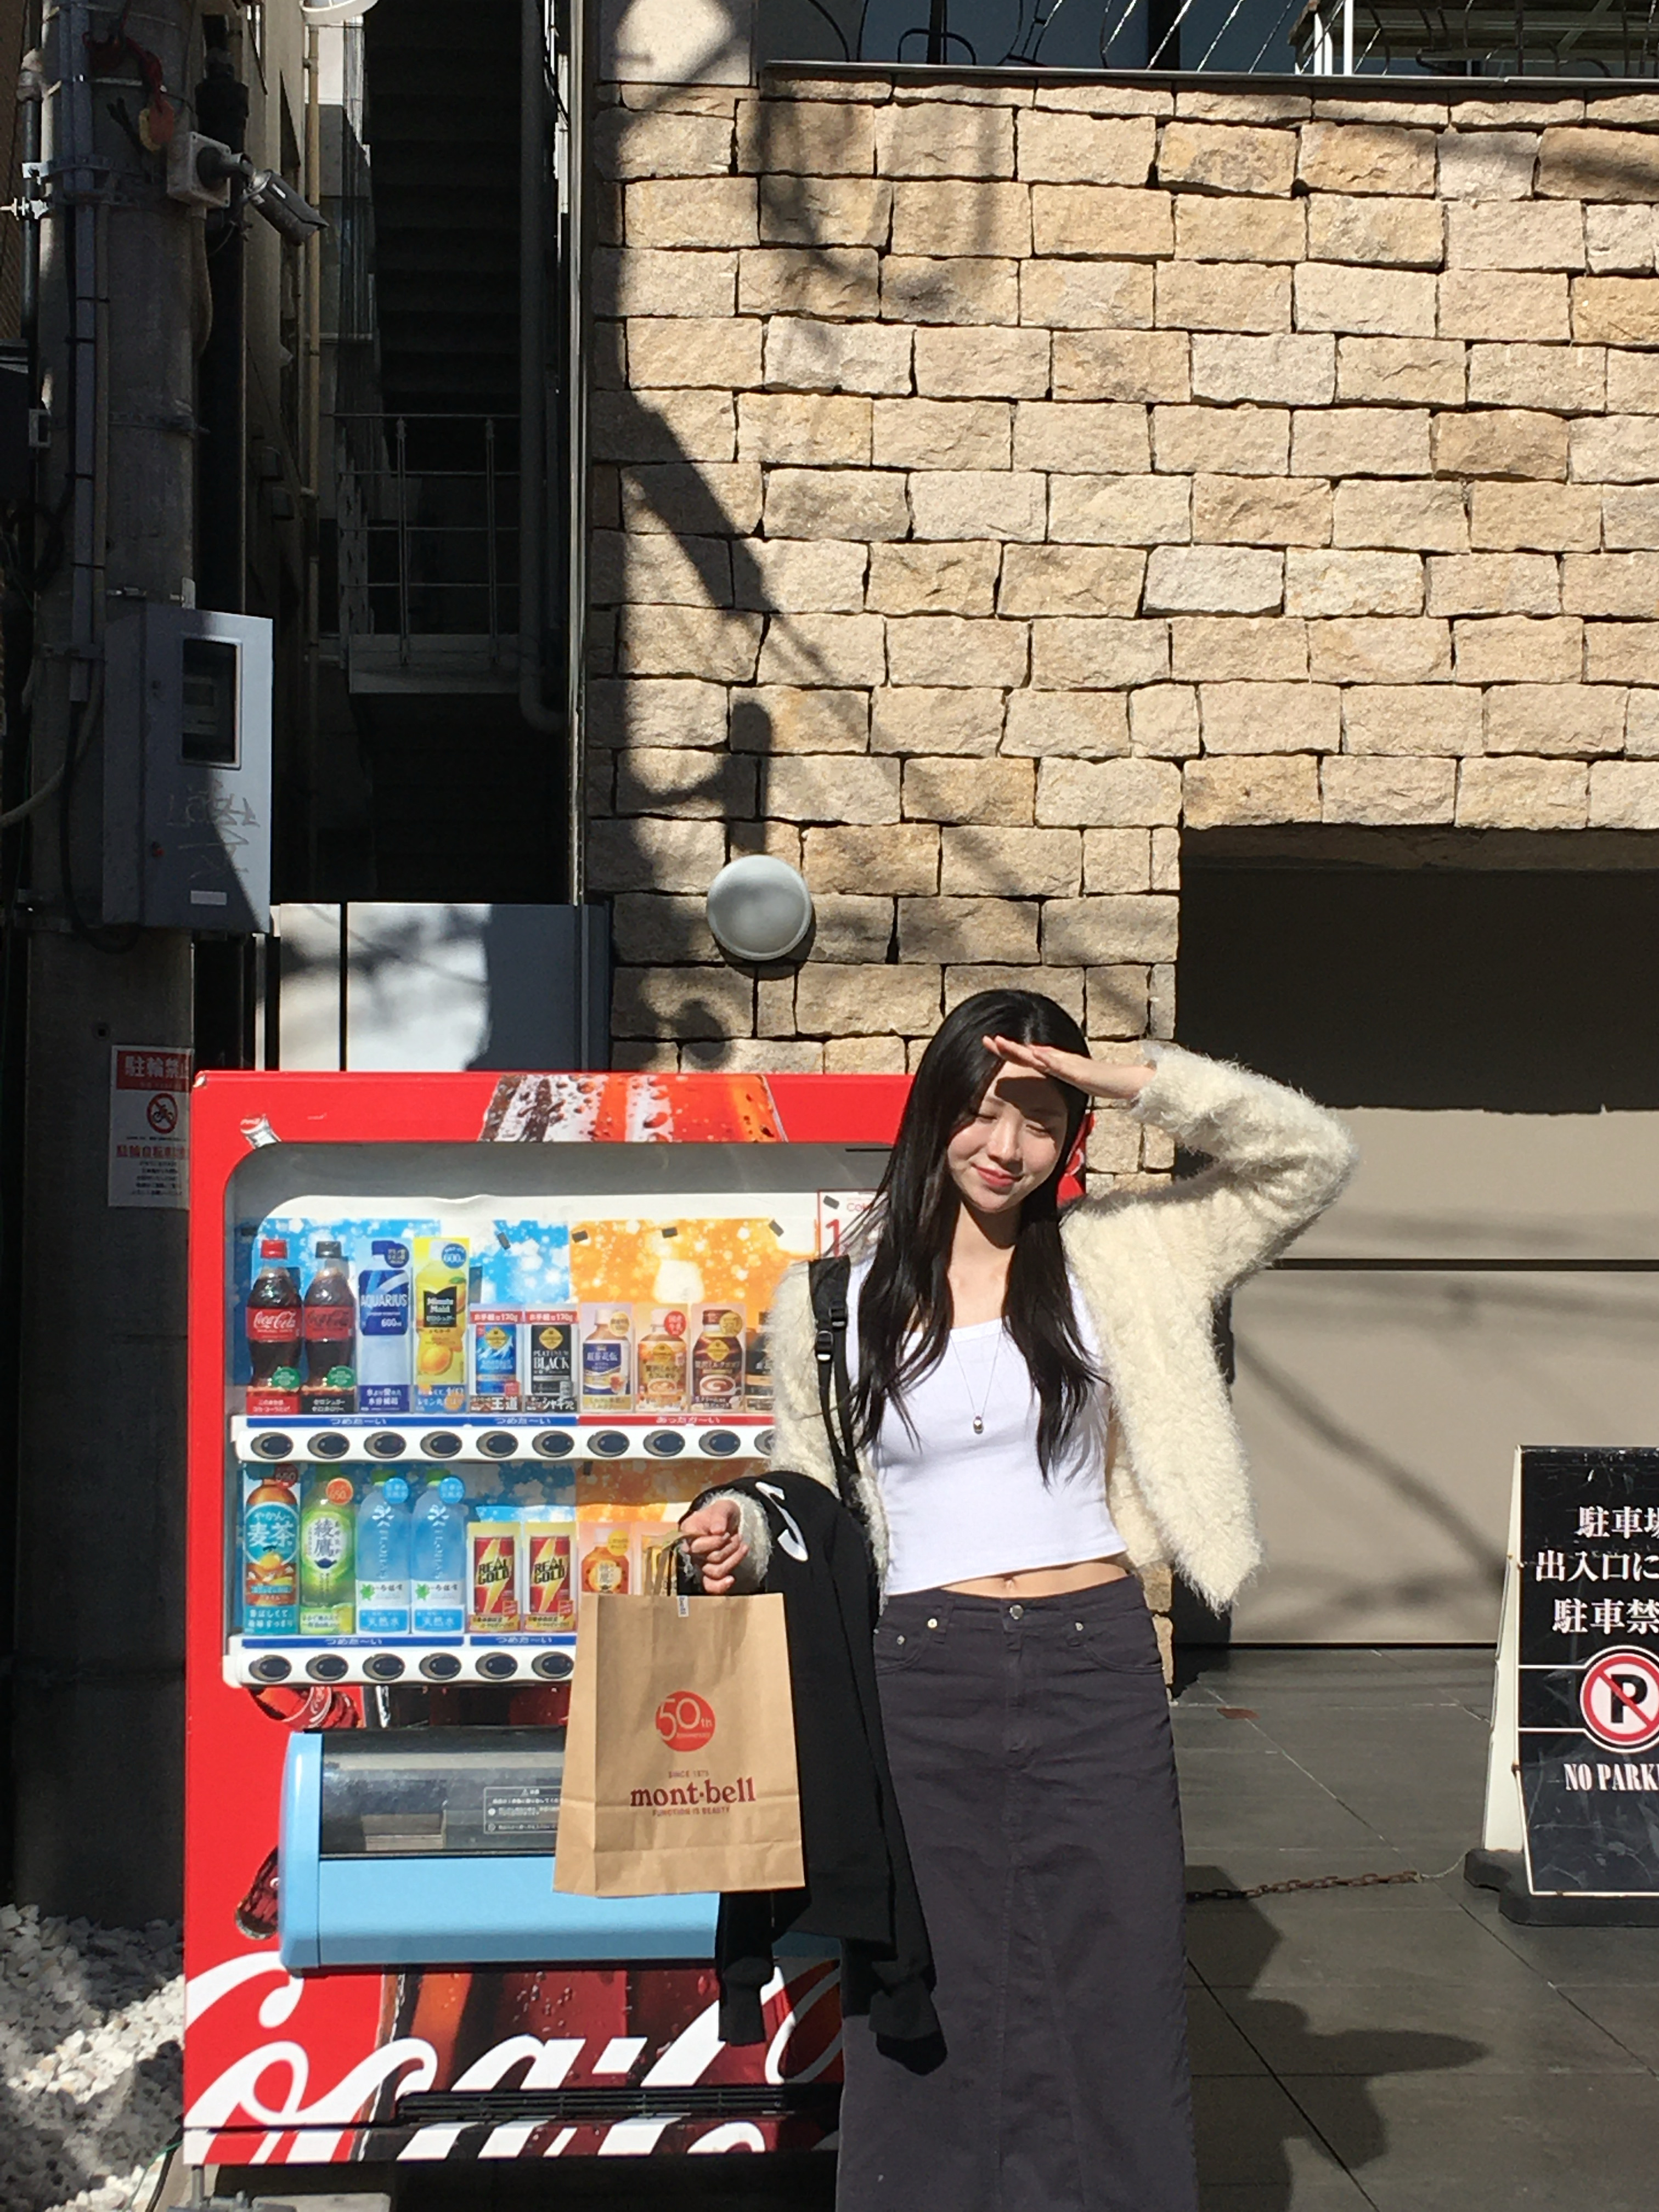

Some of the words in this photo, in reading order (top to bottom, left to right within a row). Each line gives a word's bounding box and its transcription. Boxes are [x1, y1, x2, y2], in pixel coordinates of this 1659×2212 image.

[361, 1294, 408, 1307] AQUARIUS
[253, 1310, 296, 1329] Coca-Cola
[308, 1310, 350, 1329] Coca-Cola
[533, 1357, 569, 1370] BLACK
[491, 1397, 518, 1410] 王道
[247, 1521, 295, 1547] 麦茶
[478, 1556, 509, 1573] REAL
[534, 1556, 564, 1573] REAL
[1535, 1549, 1659, 1582] 出入口に
[478, 1569, 510, 1585] GOLD
[534, 1569, 566, 1585] GOLD
[1551, 1598, 1659, 1636] 駐車禁
[1564, 1763, 1592, 1791] NO
[652, 1808, 691, 1817] FUNCTION
[702, 1805, 730, 1815] BEAUTY
